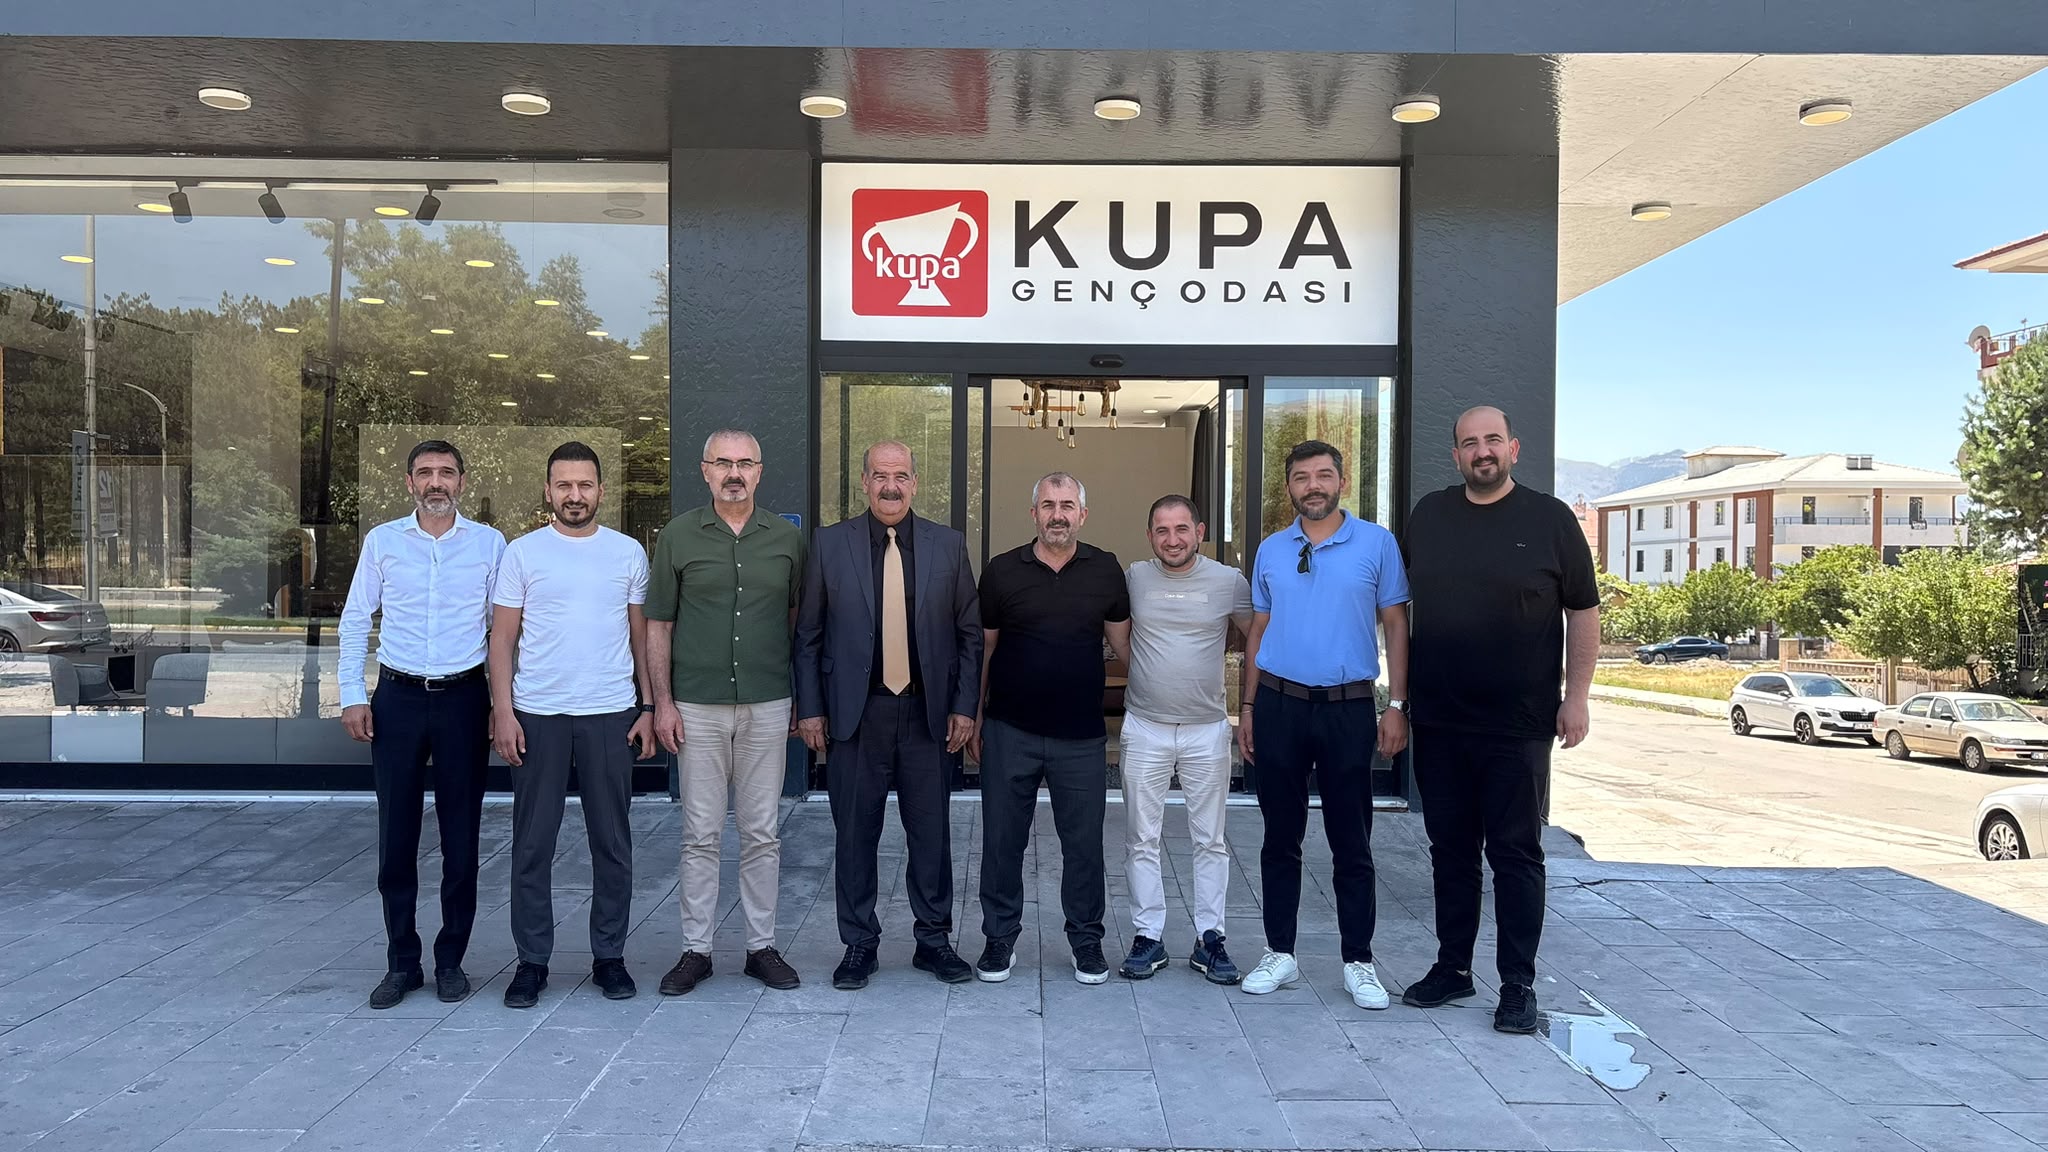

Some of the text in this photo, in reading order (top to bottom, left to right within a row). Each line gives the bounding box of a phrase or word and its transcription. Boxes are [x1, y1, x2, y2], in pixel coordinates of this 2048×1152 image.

[1014, 200, 1353, 271] KUPA
[876, 247, 961, 287] kupa
[1012, 279, 1351, 310] GENÇ ODASI
